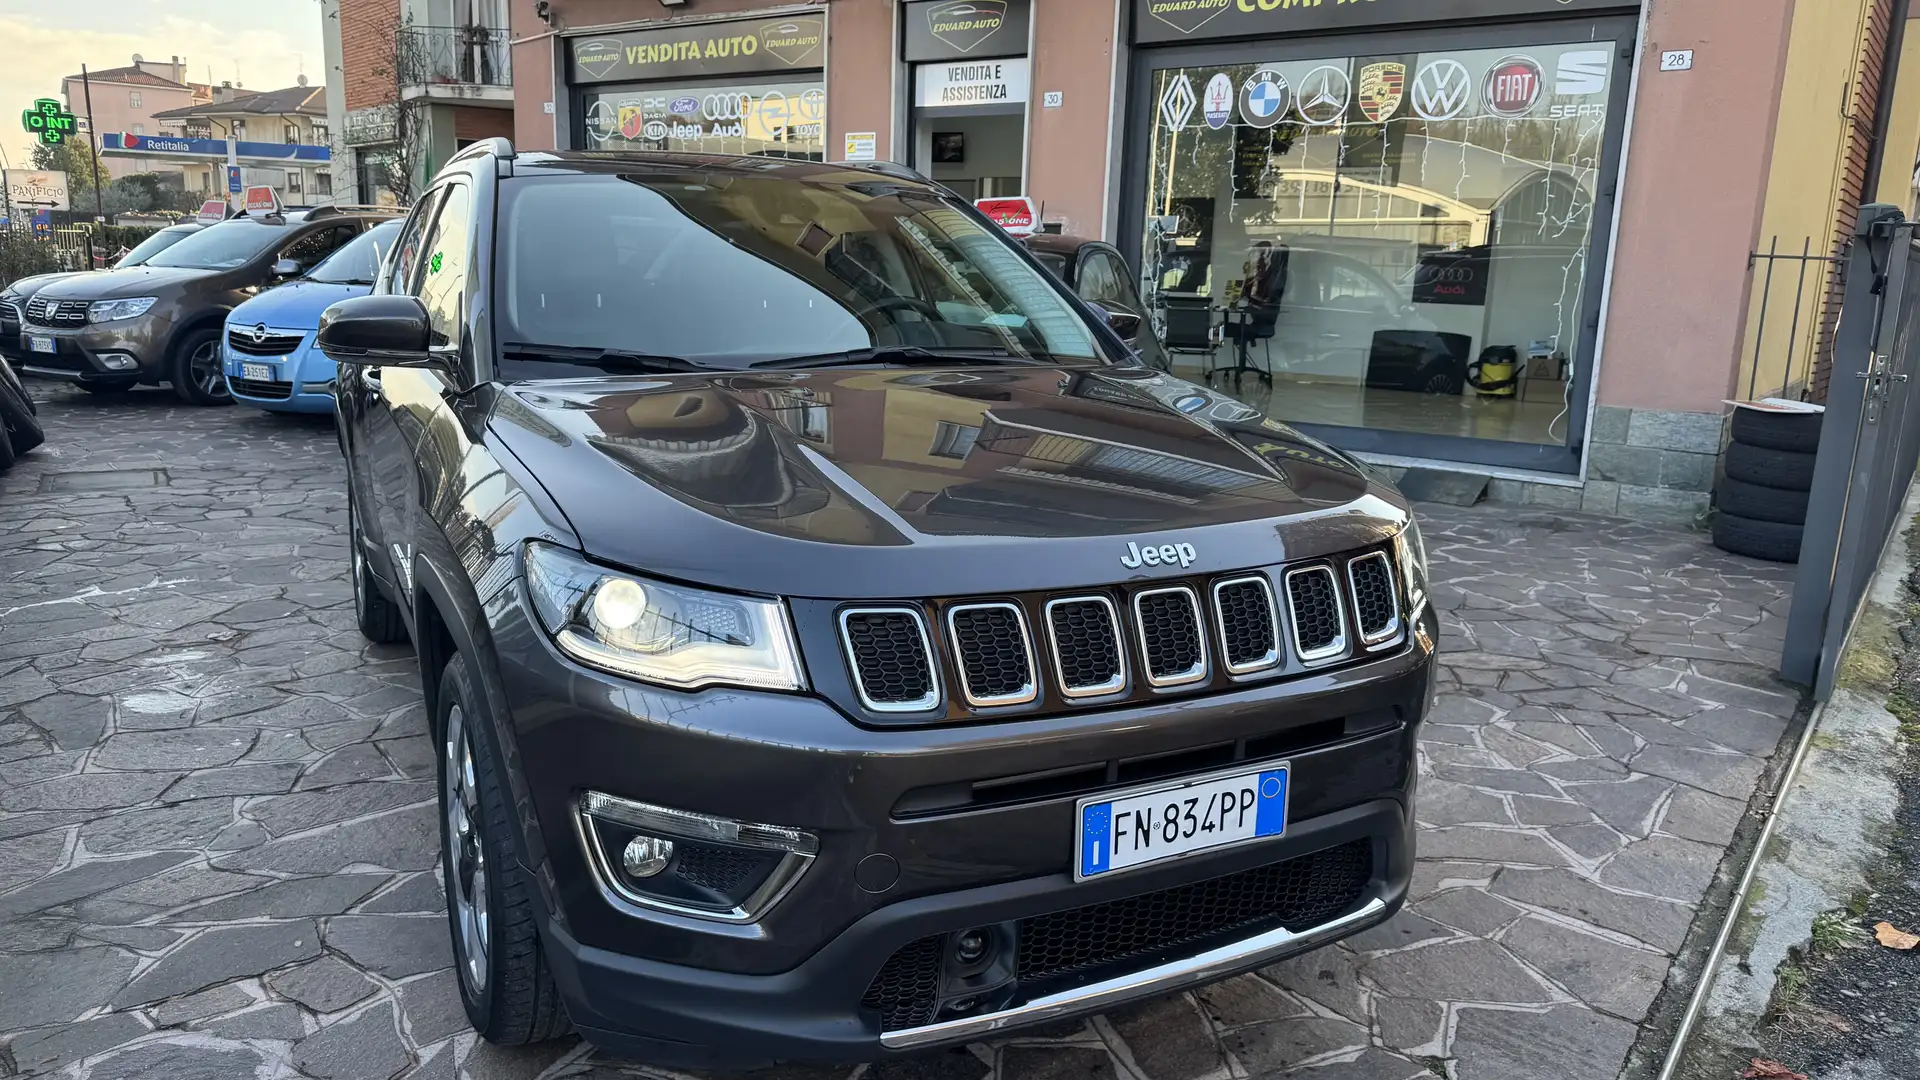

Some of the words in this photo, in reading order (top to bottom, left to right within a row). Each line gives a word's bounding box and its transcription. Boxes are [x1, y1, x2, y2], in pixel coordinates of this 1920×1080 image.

[1152, 1, 1197, 13] EDUARD
[1197, 0, 1228, 9] AUTO
[933, 21, 972, 32] EDUARD
[972, 18, 1000, 30] AUTO
[766, 38, 796, 48] EDUARD
[796, 36, 818, 46] AUTO
[625, 40, 701, 65] VENDITA
[704, 35, 758, 59] AUTO
[578, 54, 603, 64] EDUARD
[603, 52, 619, 61] AUTO
[1668, 53, 1685, 67] 28
[948, 65, 991, 82] VENDITA
[995, 64, 1002, 80] E
[1362, 64, 1403, 75] PORSCHE
[1244, 71, 1288, 92] BMW
[1496, 73, 1533, 103] FIAT
[942, 84, 1007, 102] ASSISTENZA
[1047, 94, 1059, 104] 30
[643, 112, 666, 120] DACIA
[1550, 103, 1605, 118] SEAT
[585, 116, 618, 126] NISSAN
[668, 120, 703, 140] Jeep
[711, 122, 746, 137] Audi
[795, 124, 823, 137] TOYO
[147, 139, 190, 152] Retitalia
[12, 184, 64, 198] PANIFICIO
[247, 201, 273, 209] OCCASONE
[1433, 283, 1466, 295] Audi
[1119, 541, 1197, 570] Jeep
[1113, 807, 1152, 856] FN
[1162, 787, 1256, 844] 834PP
